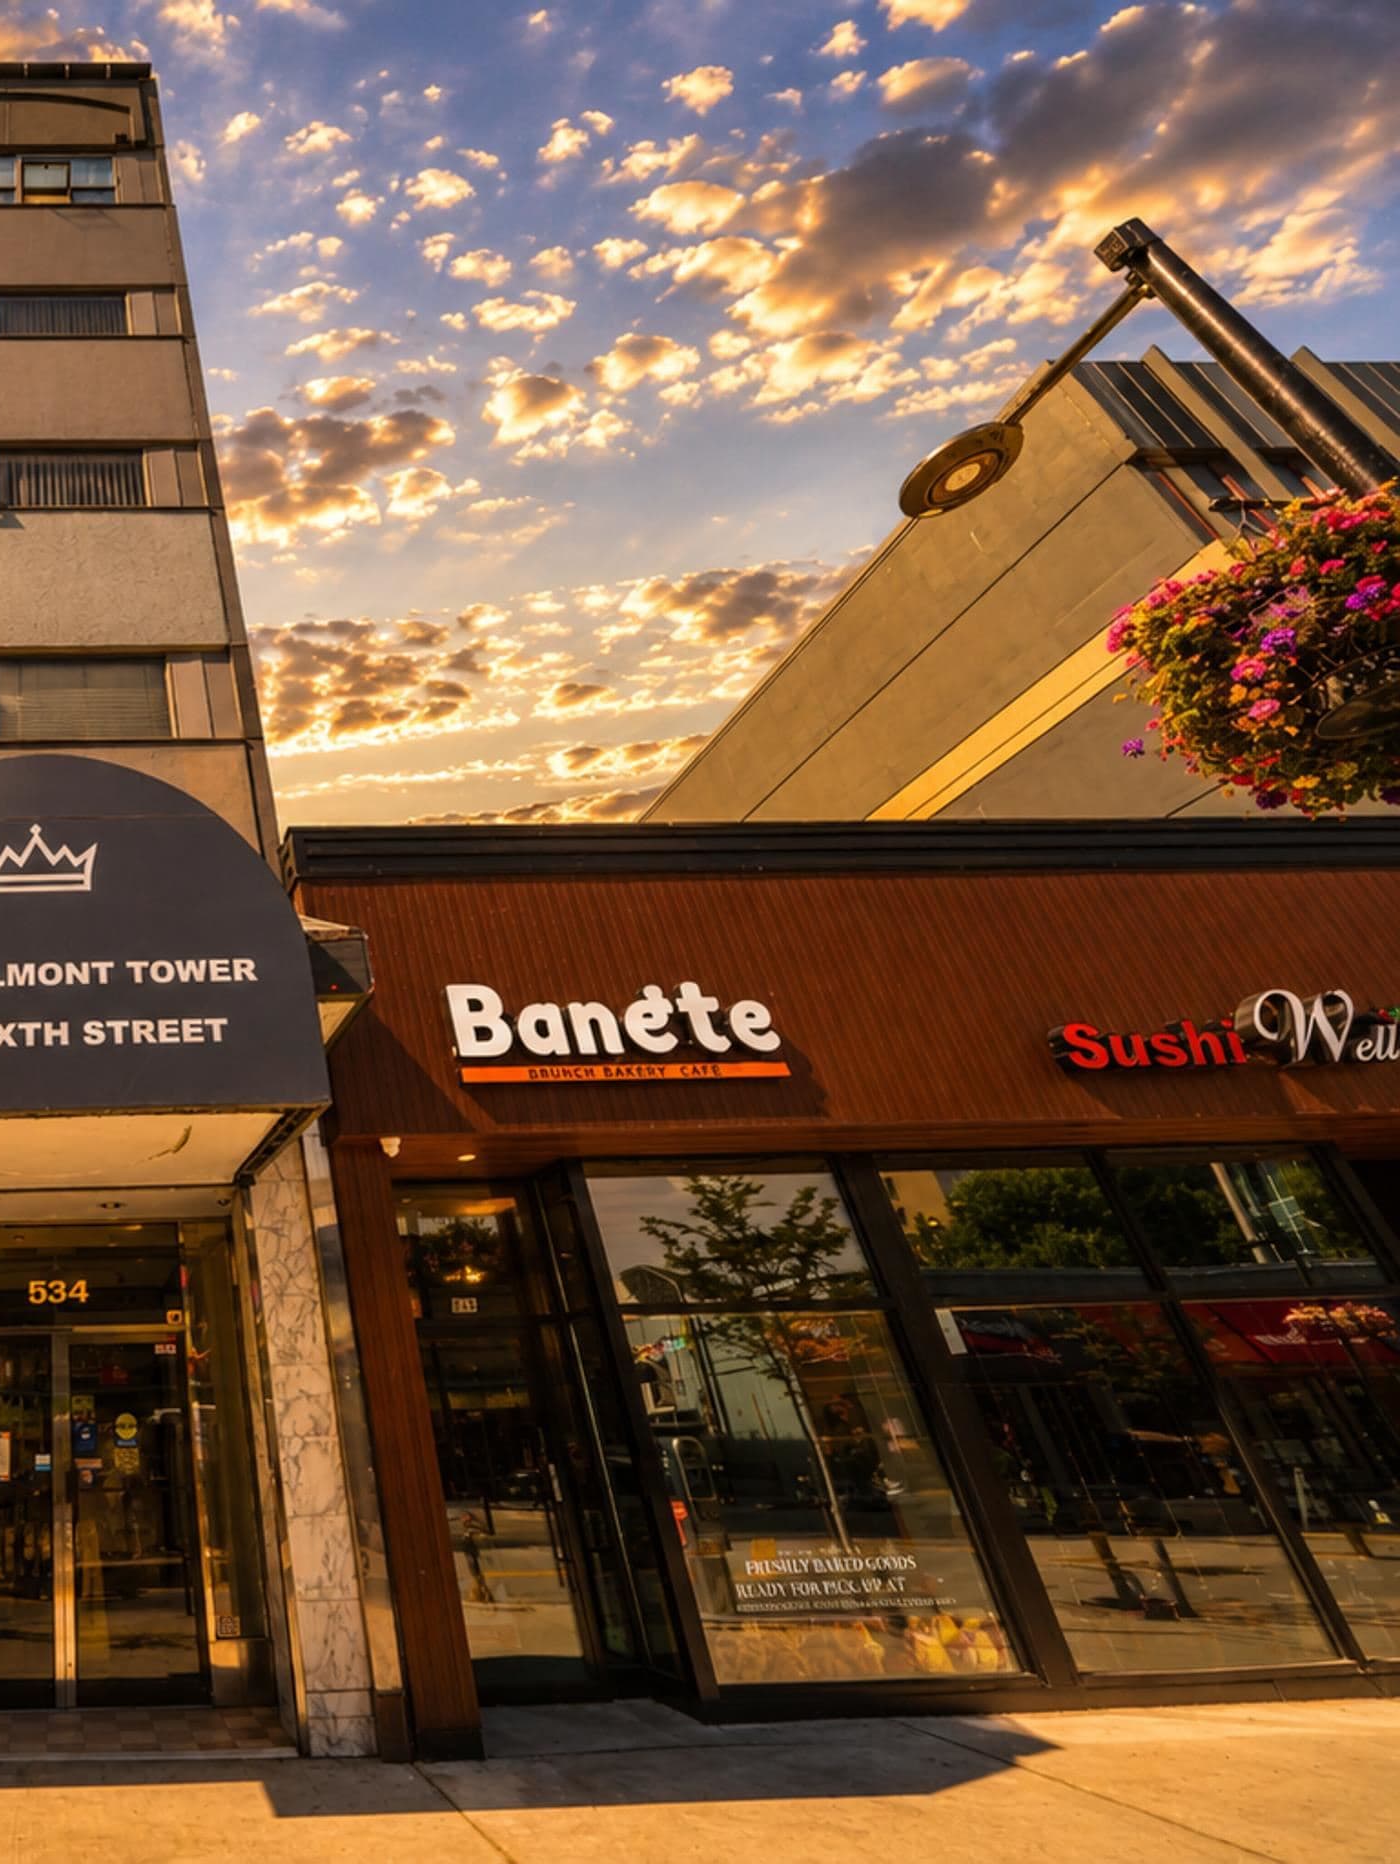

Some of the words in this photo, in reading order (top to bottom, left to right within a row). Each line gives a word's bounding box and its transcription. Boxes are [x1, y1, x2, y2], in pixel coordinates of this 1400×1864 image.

[125, 958, 258, 984] TOWER
[82, 1018, 229, 1046] STREET
[1062, 1017, 1247, 1069] Sushi
[528, 1066, 595, 1080] BRUNCH
[602, 1065, 666, 1079] BAKERY
[28, 1279, 89, 1304] 534
[865, 1555, 917, 1571] GOODS
